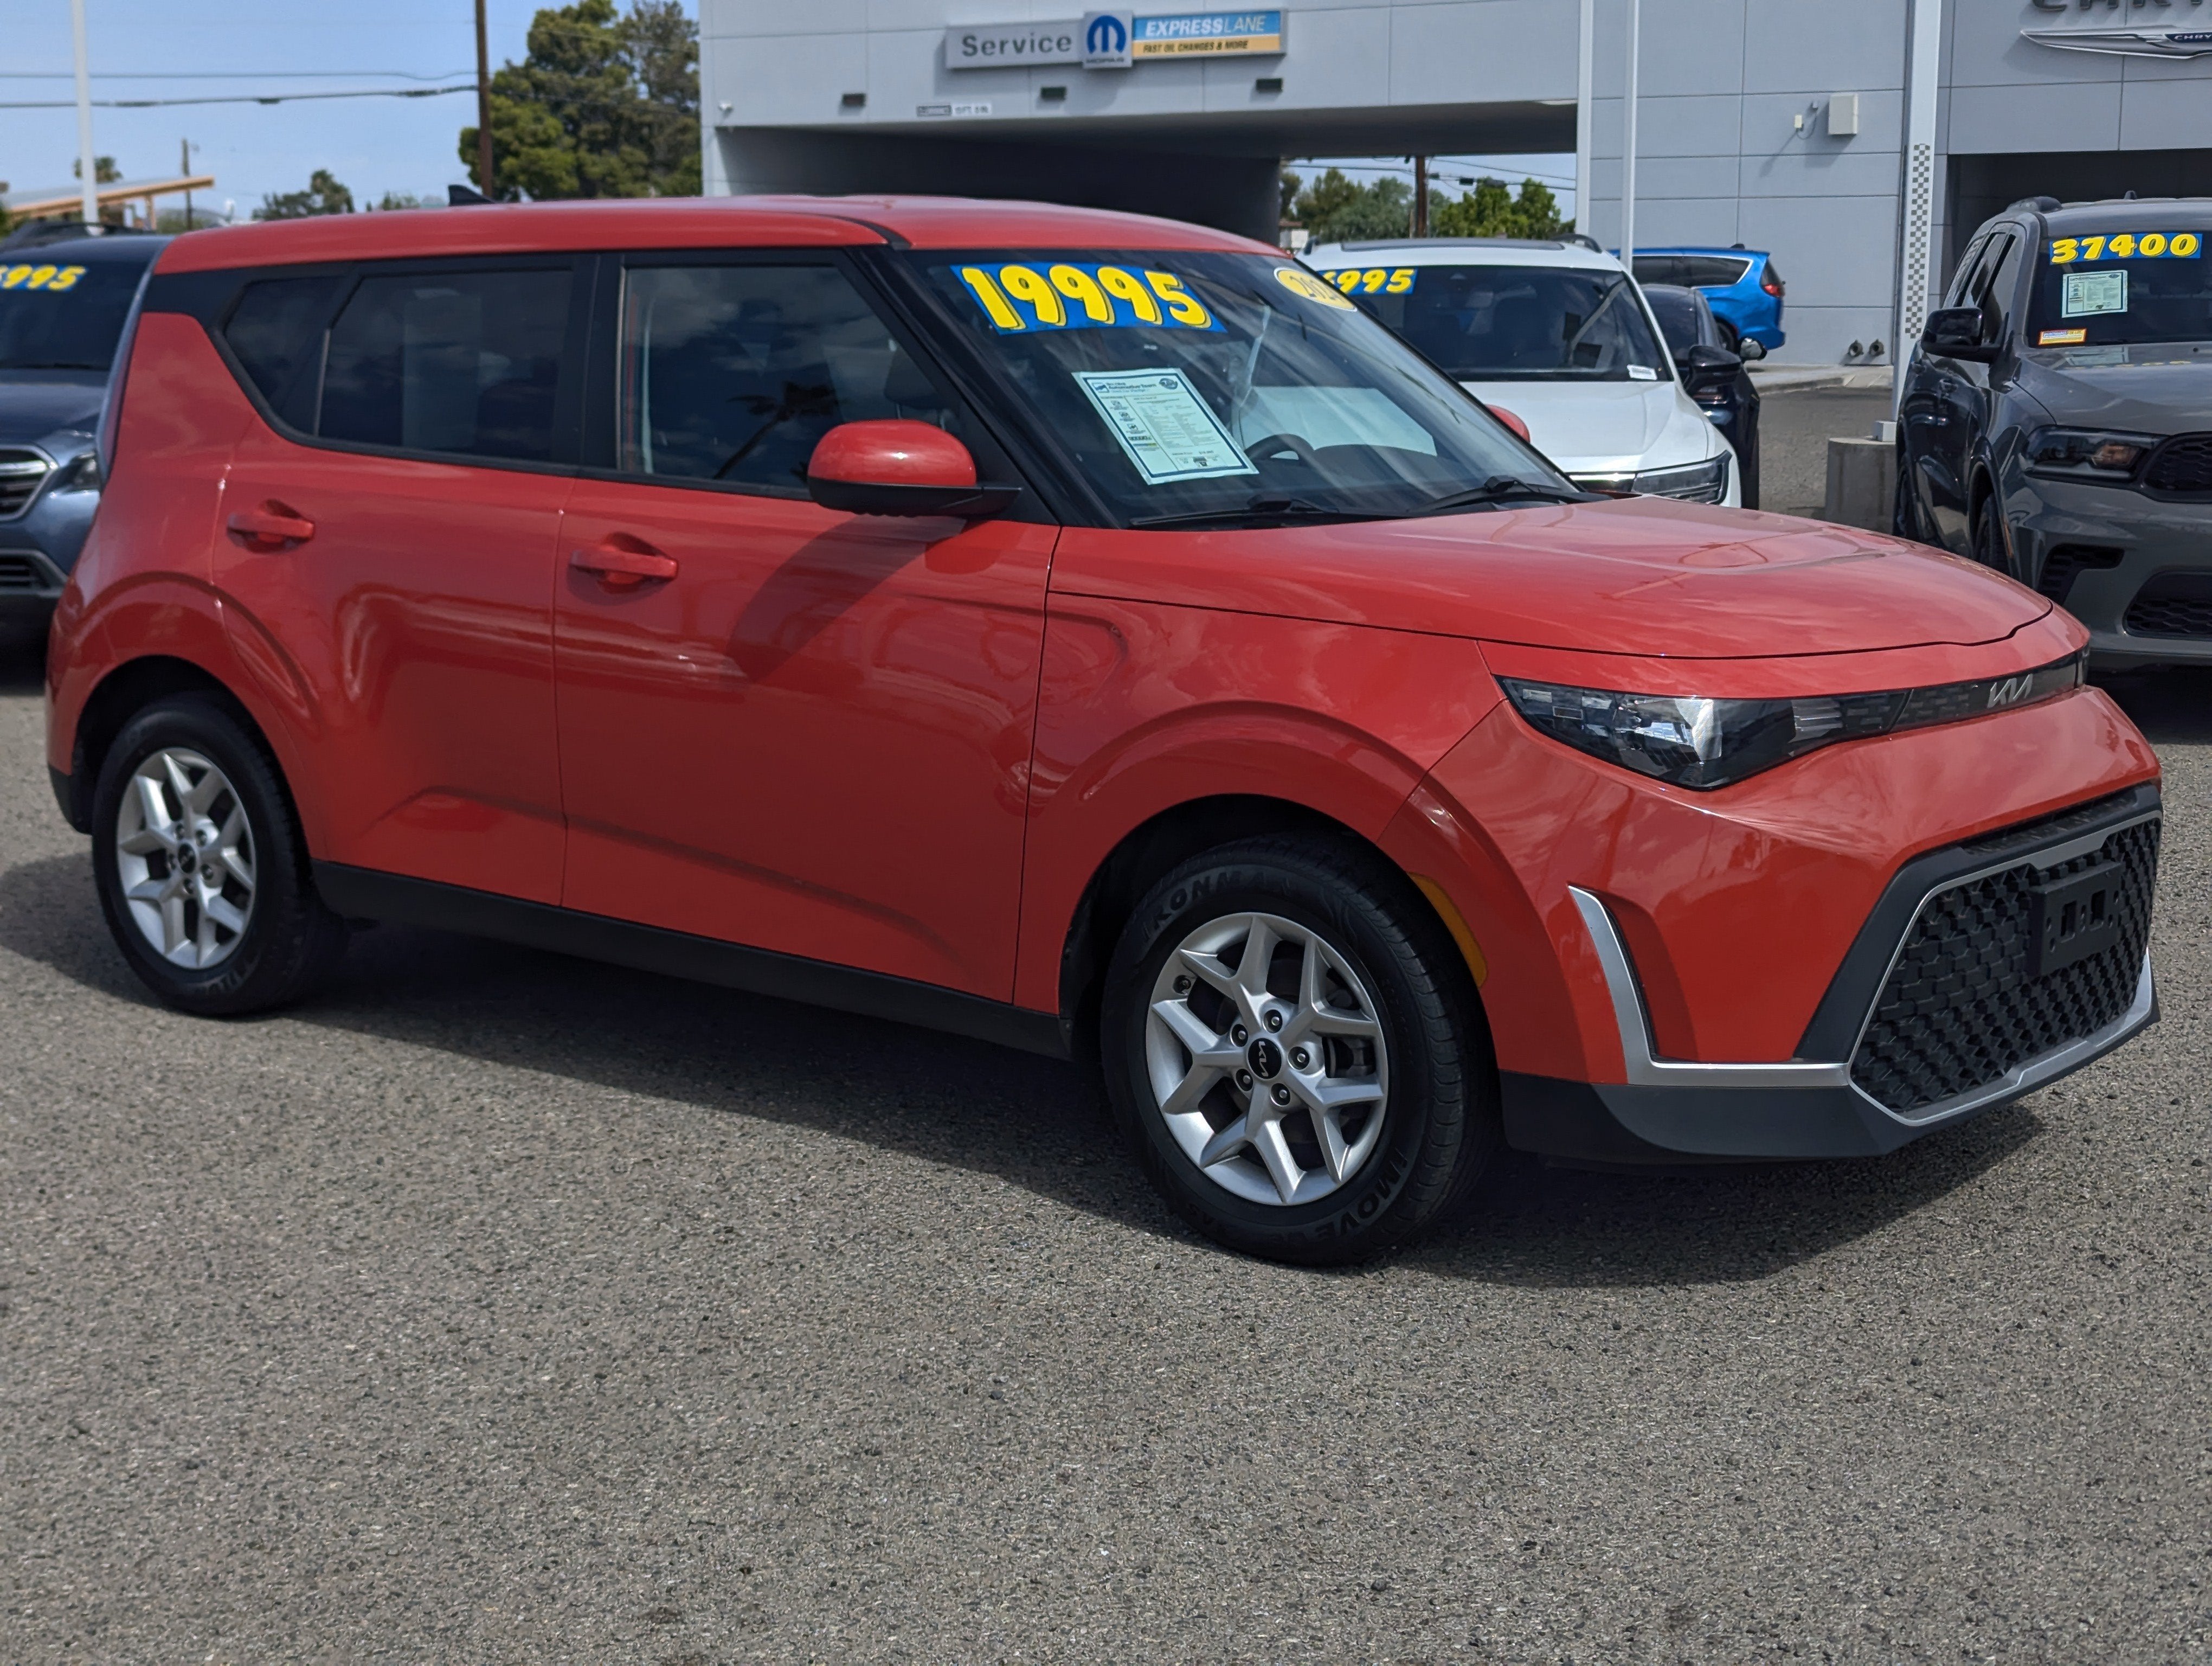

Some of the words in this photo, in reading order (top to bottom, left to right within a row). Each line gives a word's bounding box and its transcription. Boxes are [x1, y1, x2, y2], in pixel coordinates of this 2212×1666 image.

[962, 32, 1072, 57] Service
[2050, 233, 2199, 264] 37400
[0, 264, 86, 291] 995
[961, 264, 1212, 330] 19995
